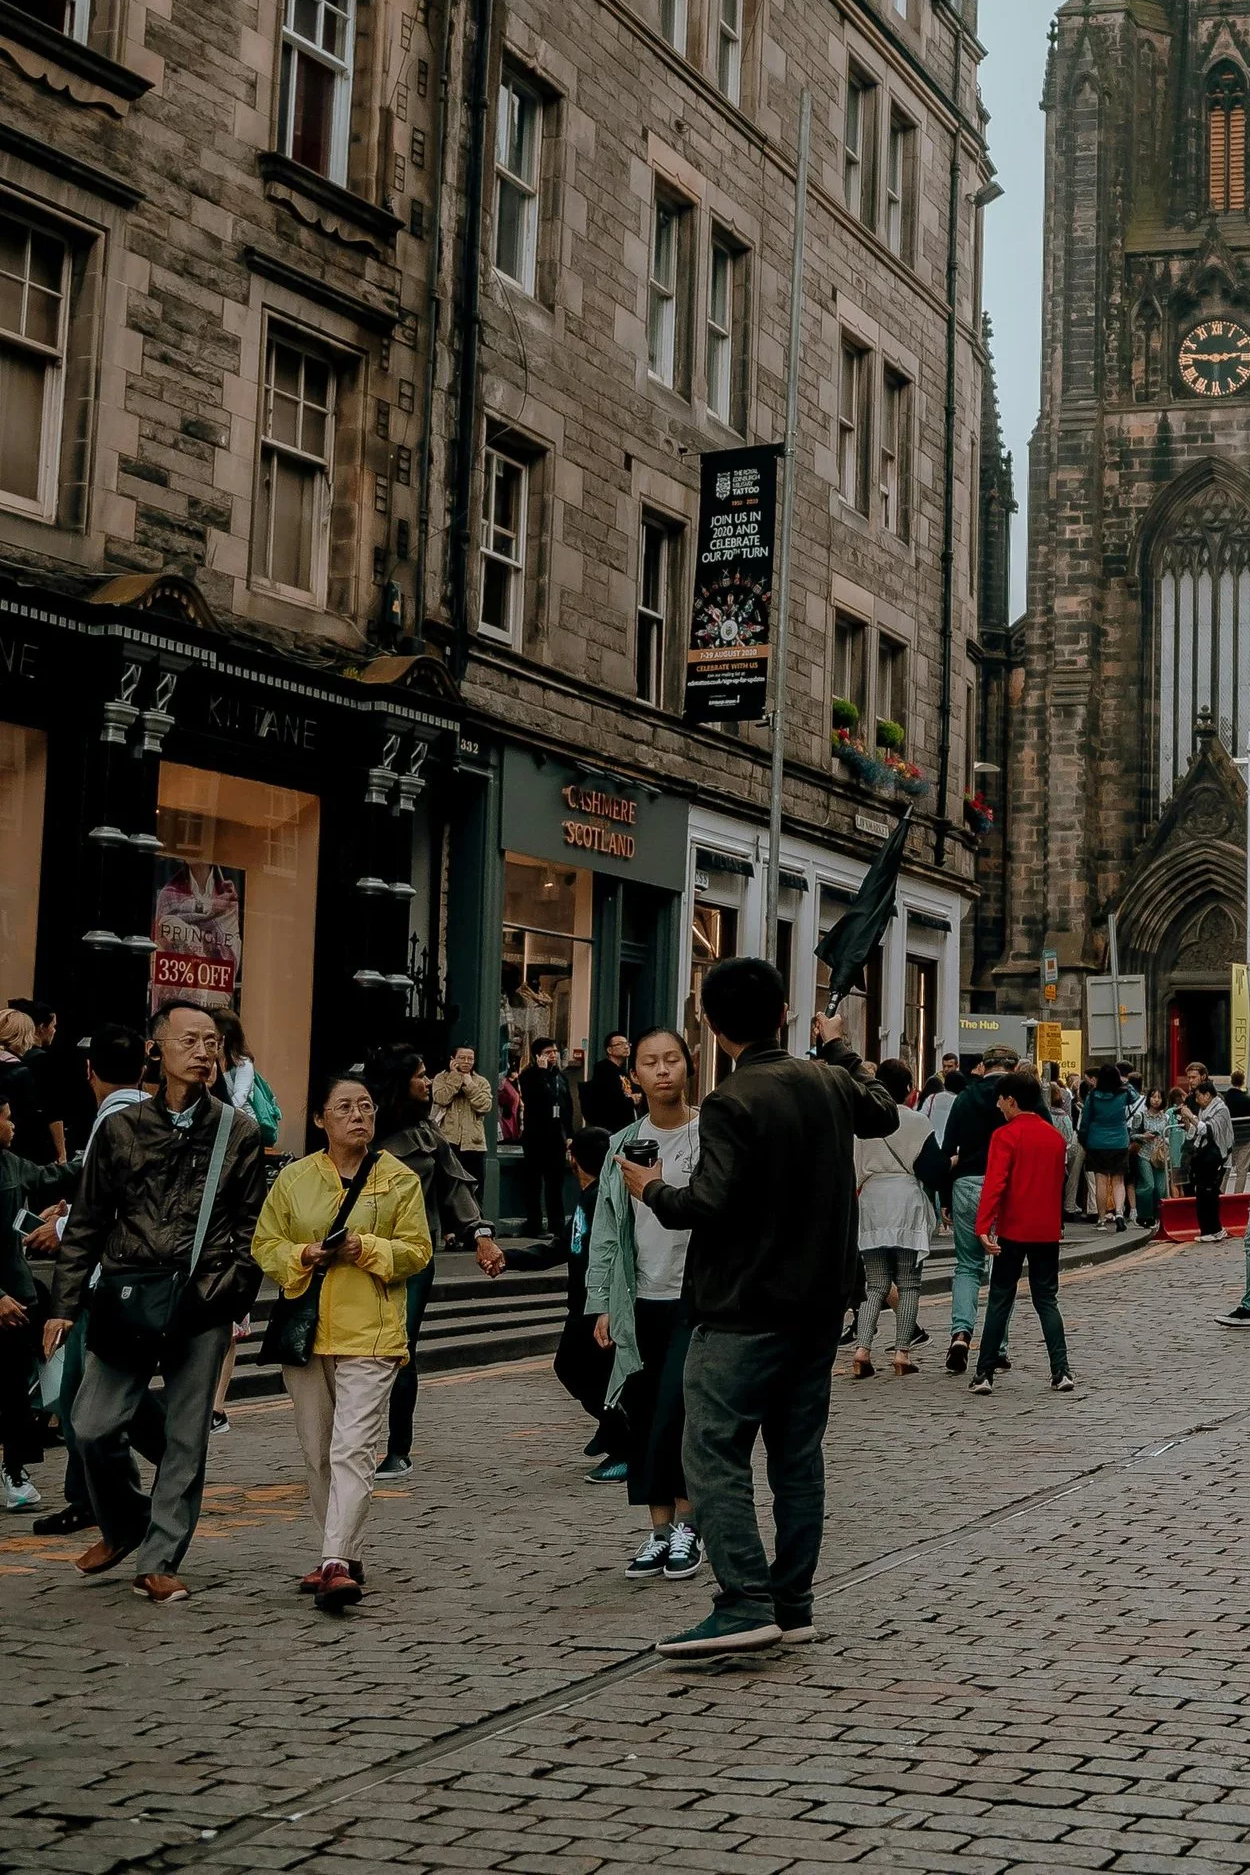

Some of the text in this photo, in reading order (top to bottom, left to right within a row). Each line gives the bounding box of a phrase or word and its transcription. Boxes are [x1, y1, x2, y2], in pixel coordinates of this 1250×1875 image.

[732, 486, 760, 496] TATTOO
[710, 511, 762, 528] JOIN US IN
[712, 523, 759, 539] 2020 AND
[709, 535, 760, 550] CELEBRATE
[701, 546, 769, 563] OUR 70TH TURN
[714, 650, 741, 659] AUGUST
[741, 648, 757, 657] 2020
[696, 663, 730, 673] CELEBRATE
[731, 662, 749, 670] WITH
[460, 738, 479, 754] 332
[567, 785, 637, 824] CASHMERE
[566, 821, 635, 858] SCOTLAND
[161, 924, 234, 947] PRINGLE
[159, 959, 231, 987] 33% OFF
[960, 1019, 1000, 1030] The Hub
[1235, 1016, 1247, 1074] FESTIVA
